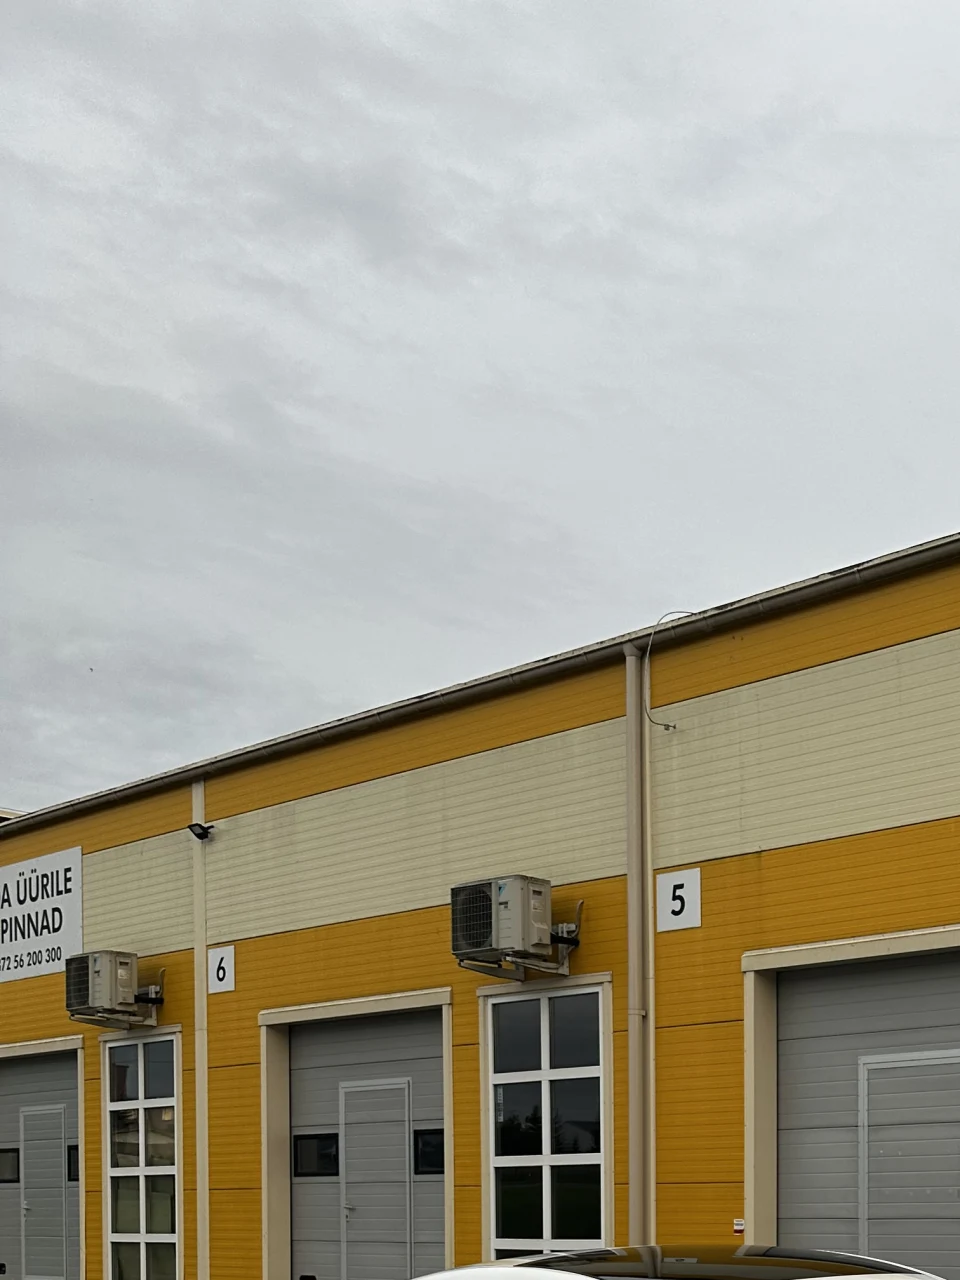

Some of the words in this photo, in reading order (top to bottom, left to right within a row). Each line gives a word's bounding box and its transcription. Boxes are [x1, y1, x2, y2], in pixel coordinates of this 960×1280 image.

[16, 867, 72, 906] ÜÜRILE
[670, 883, 686, 917] 5
[0, 906, 63, 944] PINNAD
[0, 956, 11, 972] 72
[13, 954, 25, 970] 56
[26, 949, 43, 967] 200
[45, 946, 62, 964] 300
[216, 956, 227, 983] 6
